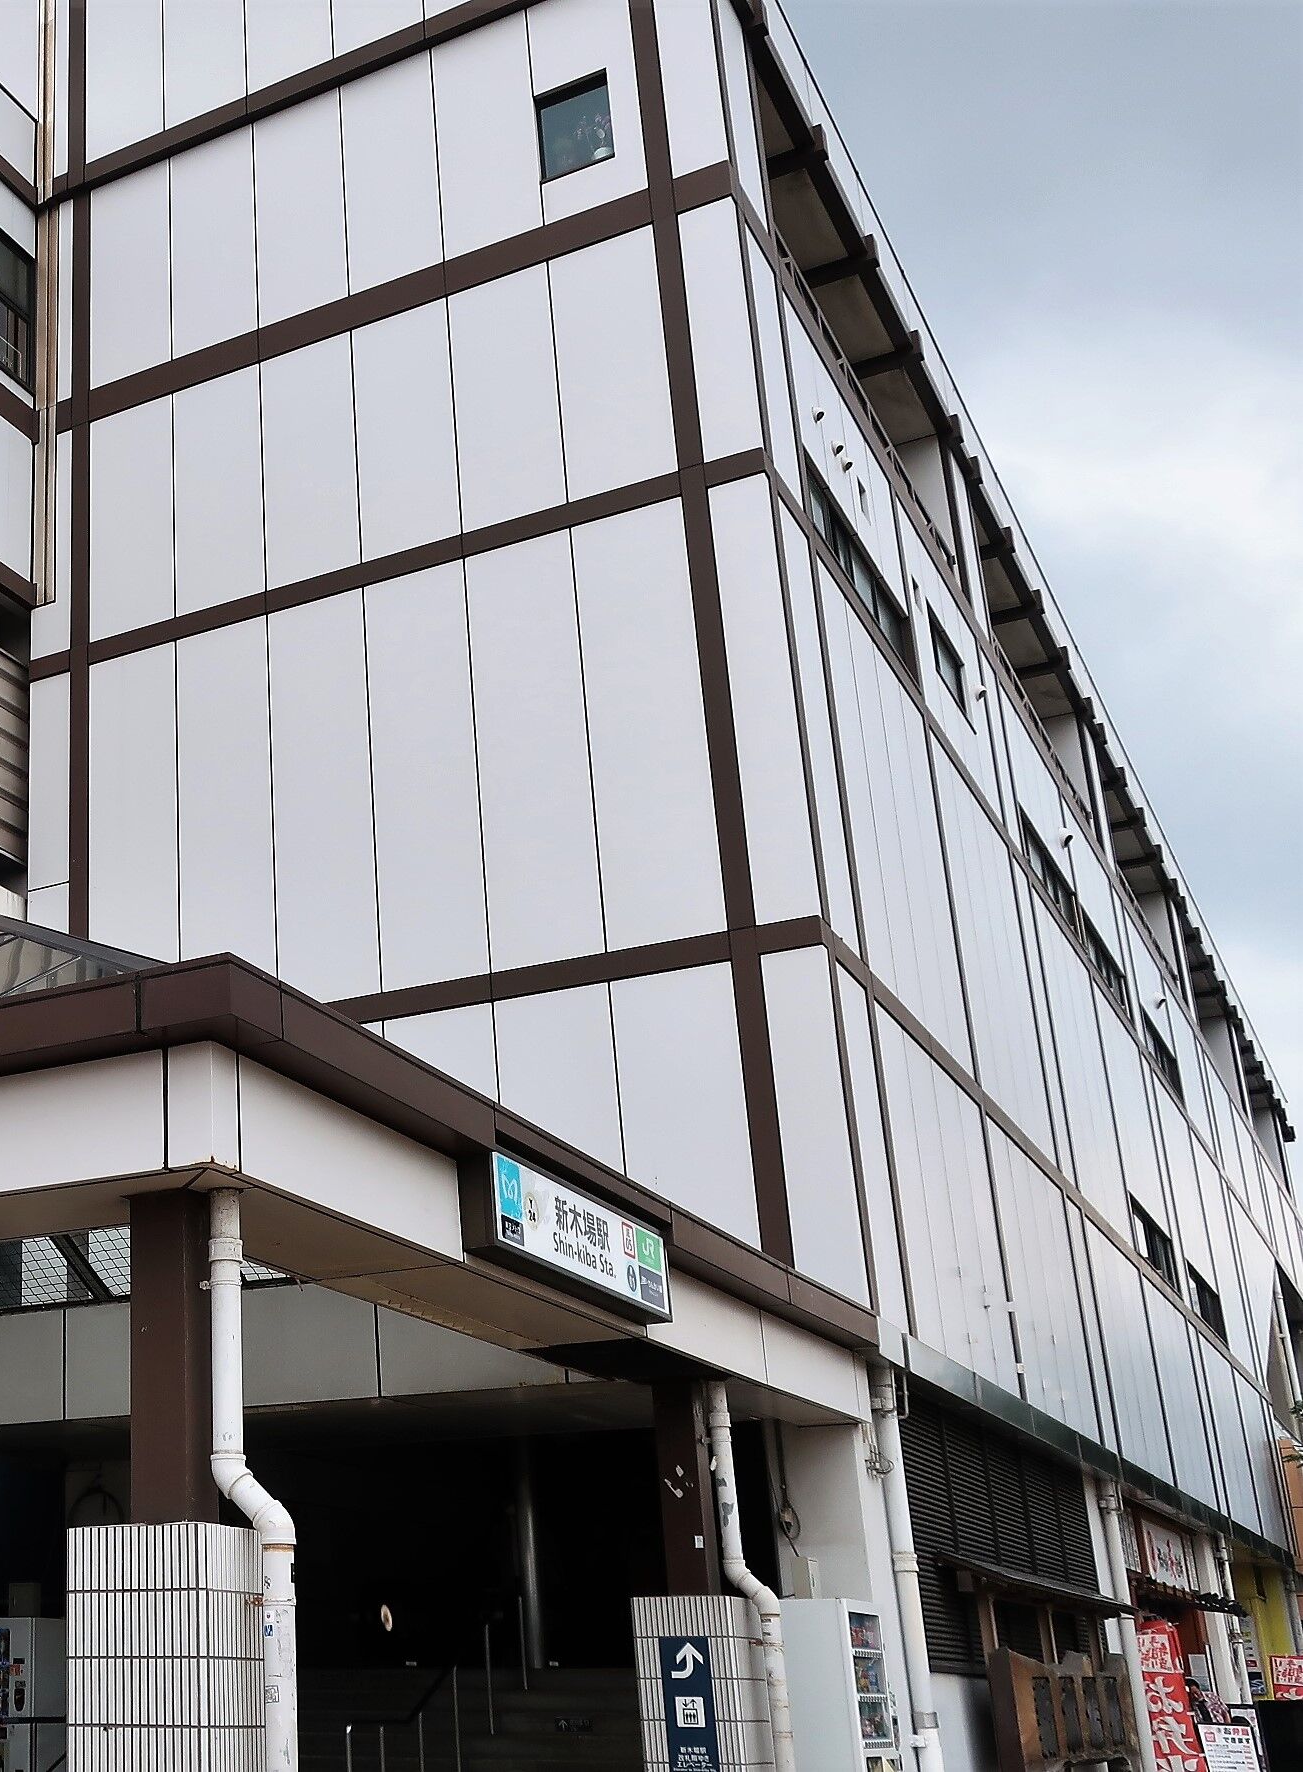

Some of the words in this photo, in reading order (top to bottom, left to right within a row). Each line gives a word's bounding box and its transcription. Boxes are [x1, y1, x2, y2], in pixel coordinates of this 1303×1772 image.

[554, 1195, 611, 1253] 新木場駅
[553, 1231, 597, 1270] Shin-kiba
[599, 1254, 617, 1279] Sta.
